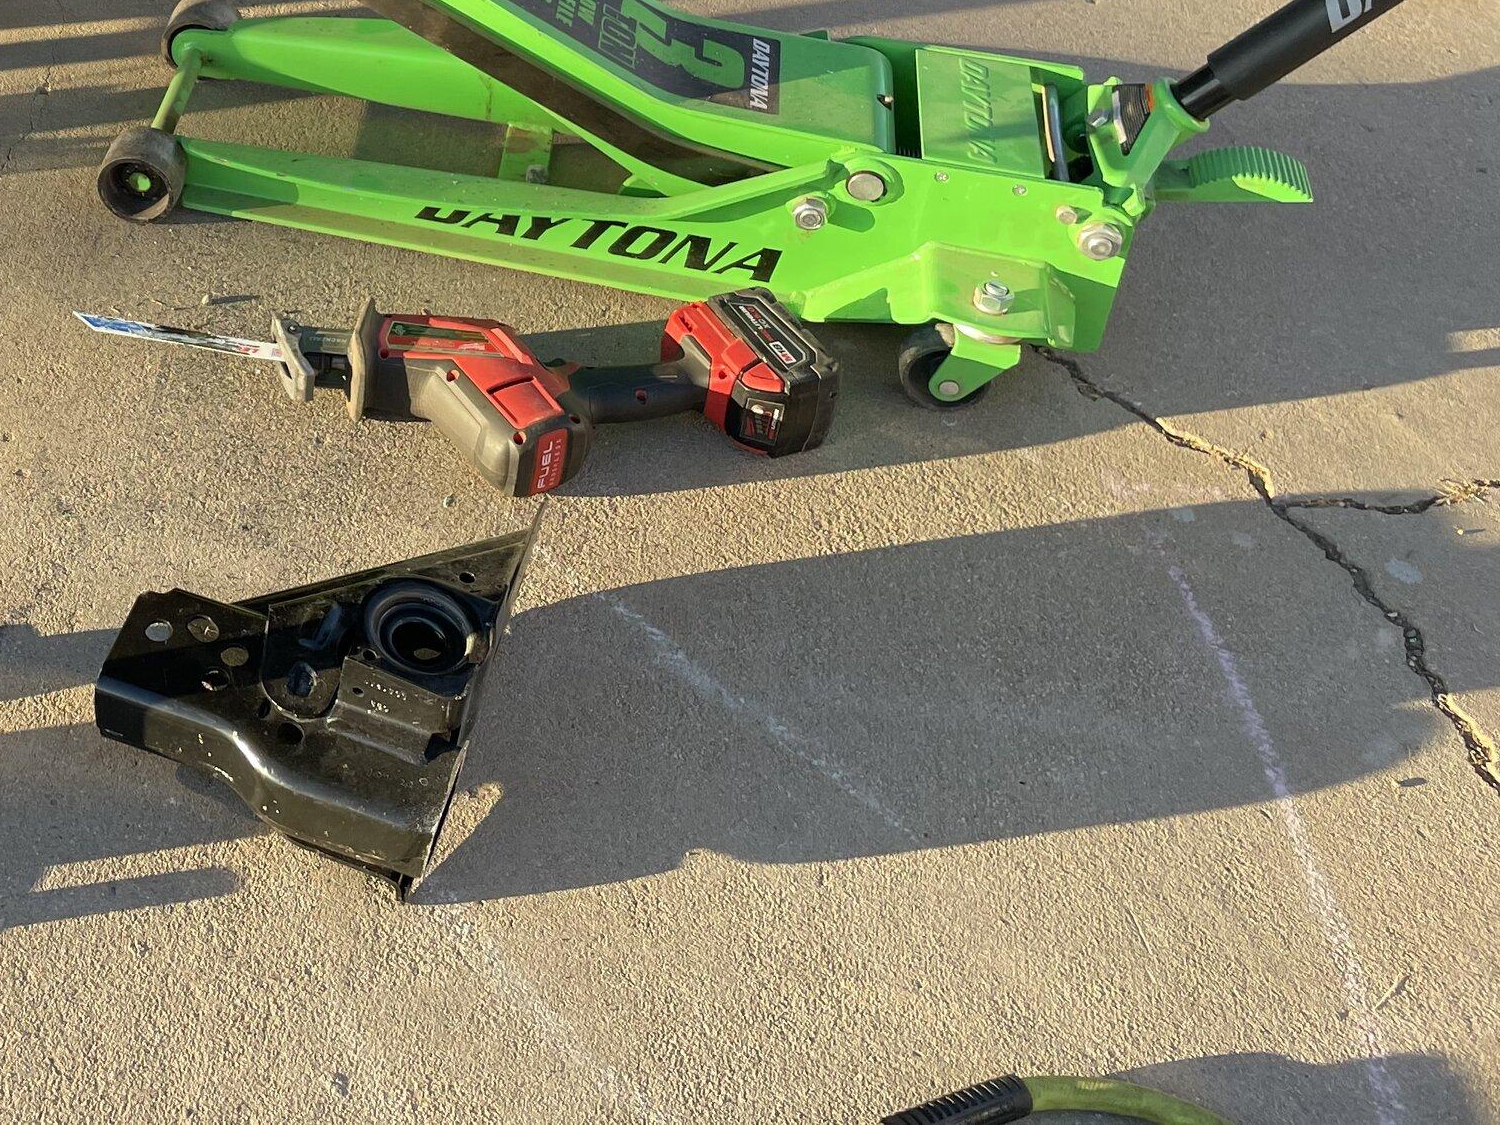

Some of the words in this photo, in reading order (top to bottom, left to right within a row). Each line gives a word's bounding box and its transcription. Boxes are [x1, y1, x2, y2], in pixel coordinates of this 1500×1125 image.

[598, 3, 638, 70] TON
[750, 38, 770, 110] DAYTONA
[537, 441, 553, 489] FUEL
